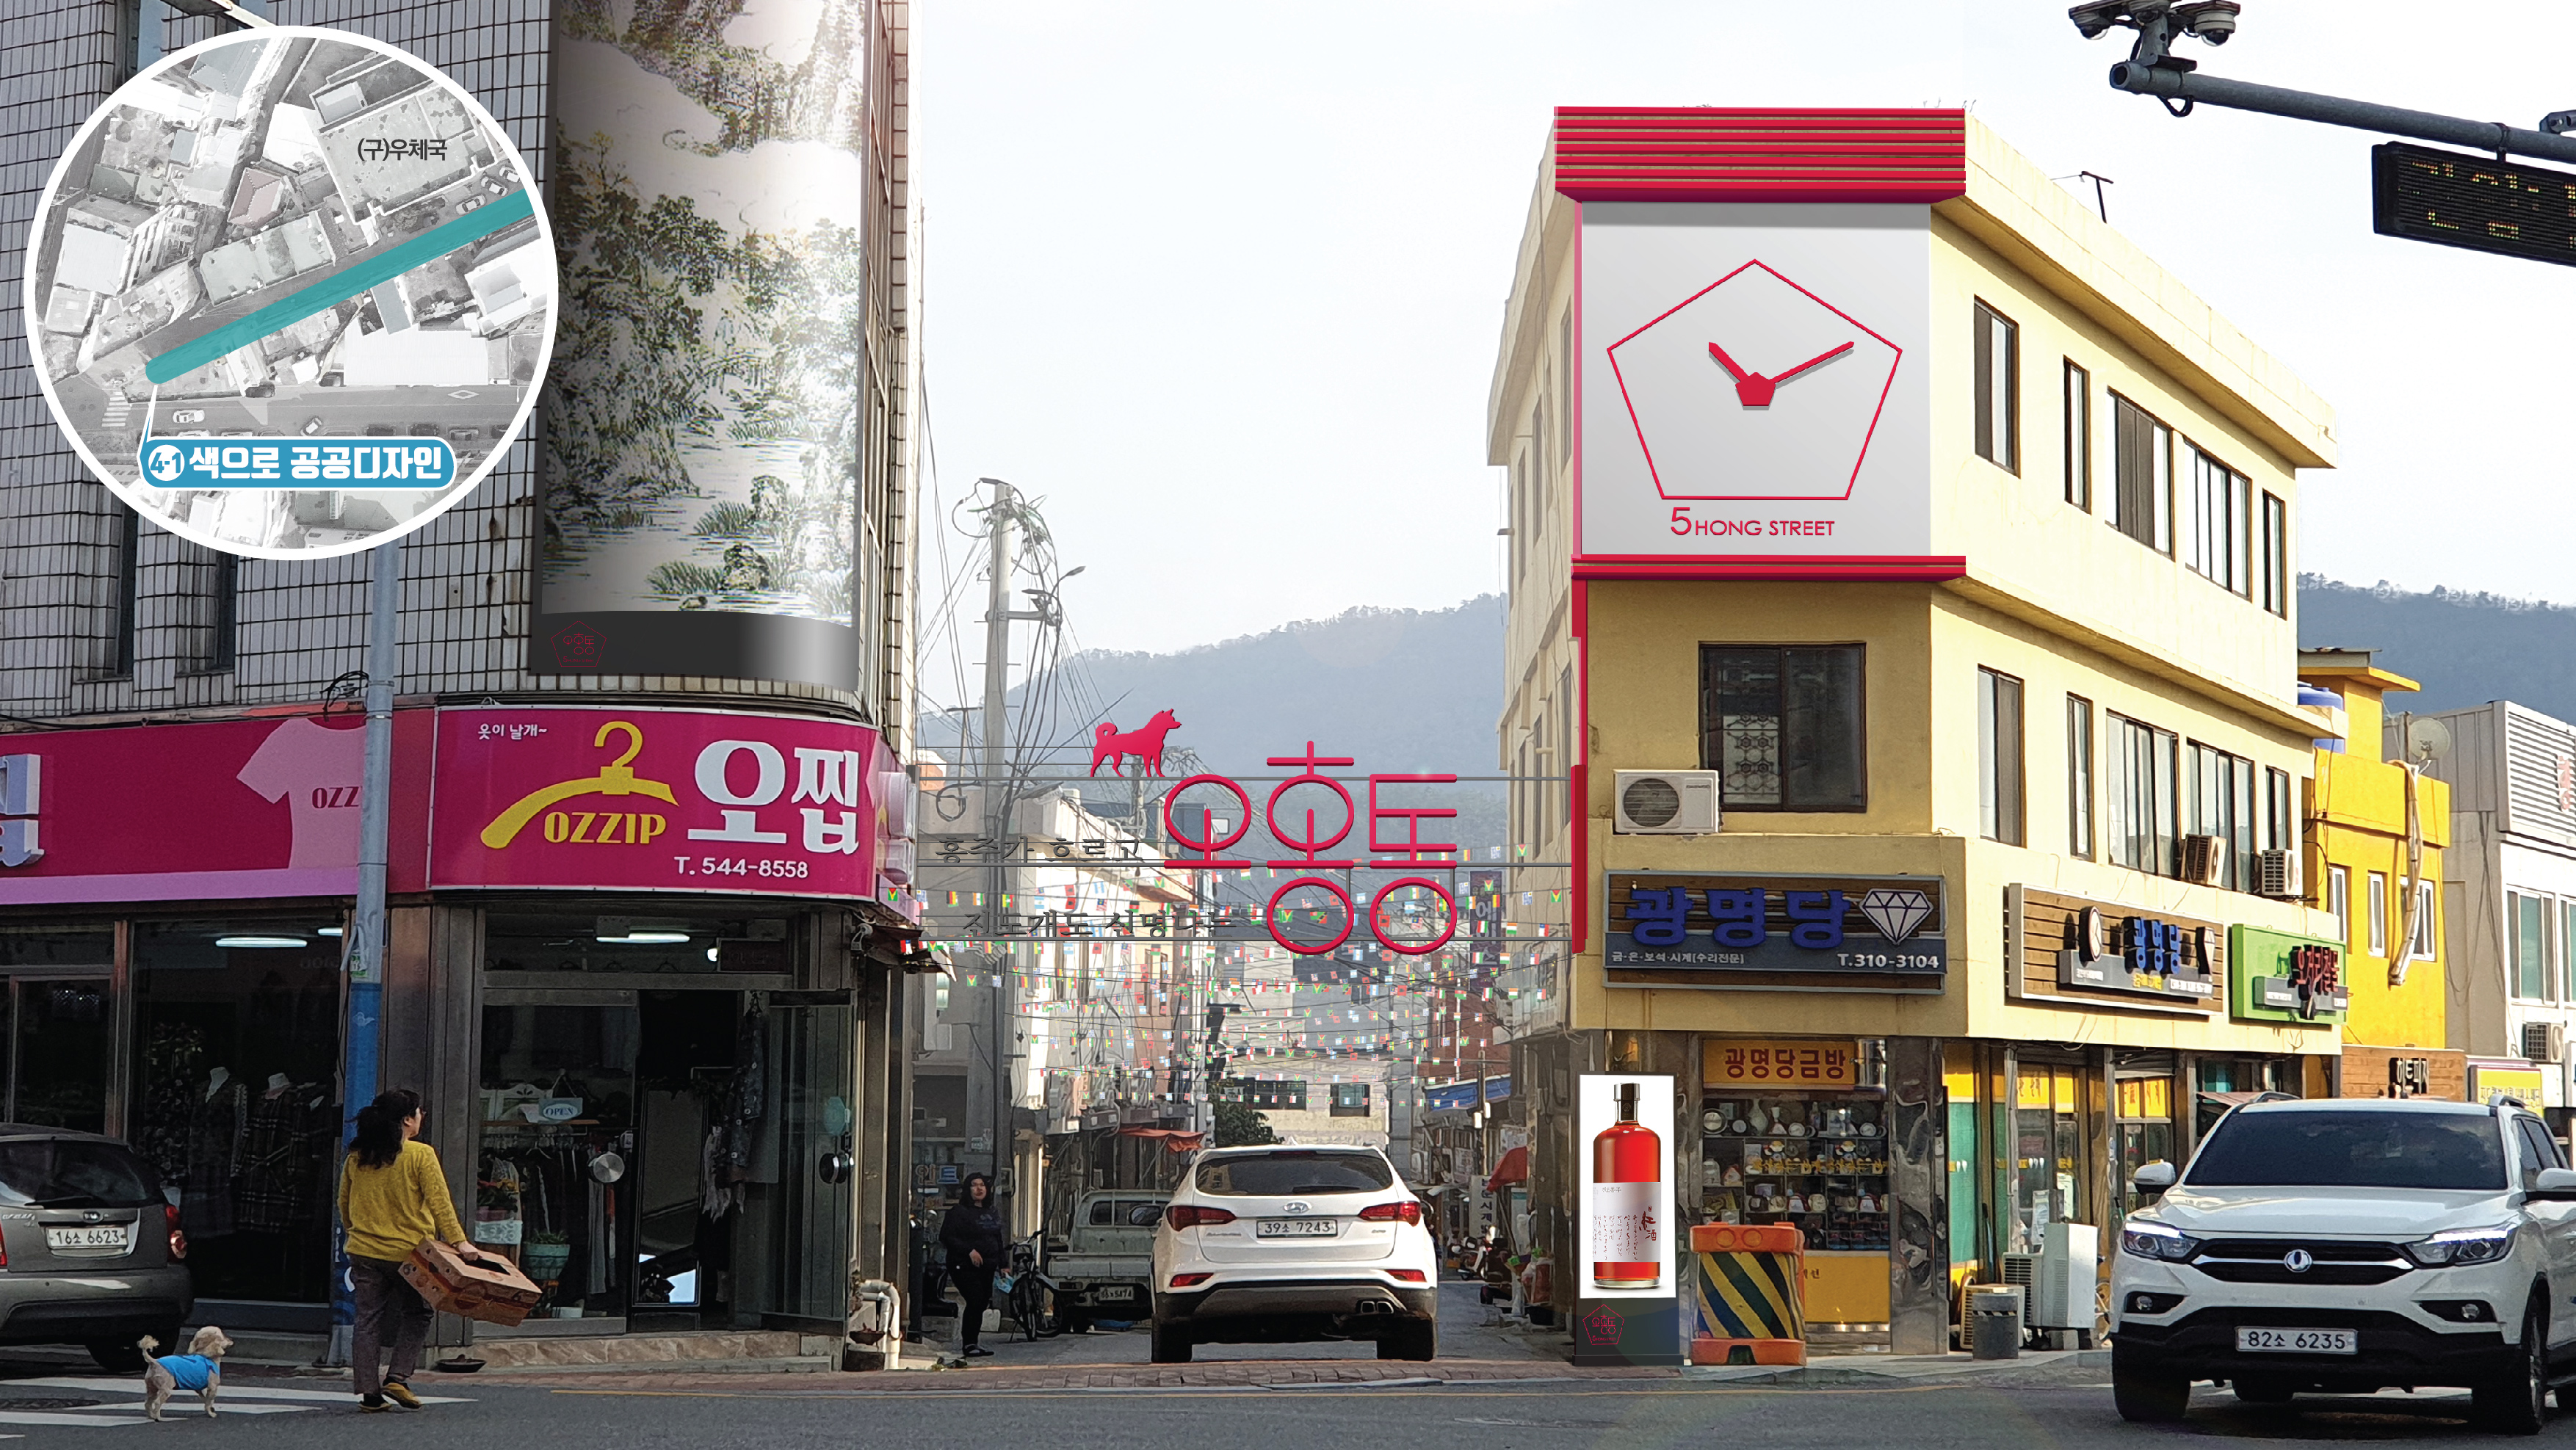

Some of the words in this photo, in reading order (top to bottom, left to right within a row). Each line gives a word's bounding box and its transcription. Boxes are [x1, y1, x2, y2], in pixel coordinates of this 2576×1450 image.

[1768, 520, 1835, 536] STREET
[477, 723, 504, 741] 옷이
[312, 785, 360, 809] OZZ
[687, 739, 859, 854] 오찝
[543, 811, 666, 845] OZZIP
[934, 835, 1035, 863] 홍주가
[1044, 837, 1143, 863] 흐르고
[674, 856, 695, 876] T.
[701, 857, 809, 880] 544-8558
[963, 910, 1093, 938] 진도개도
[1104, 910, 1237, 938] 신명나는
[1624, 885, 1852, 949] 광명당
[1725, 1048, 1846, 1079] 광명당금방
[545, 1107, 574, 1116] OPEN
[56, 1230, 82, 1245] 16소
[87, 1230, 120, 1244] 6623
[1265, 1223, 1290, 1234] 39소
[1296, 1222, 1331, 1233] 7243
[2248, 1331, 2286, 1347] 82소
[2295, 1333, 2346, 1349] 6235
